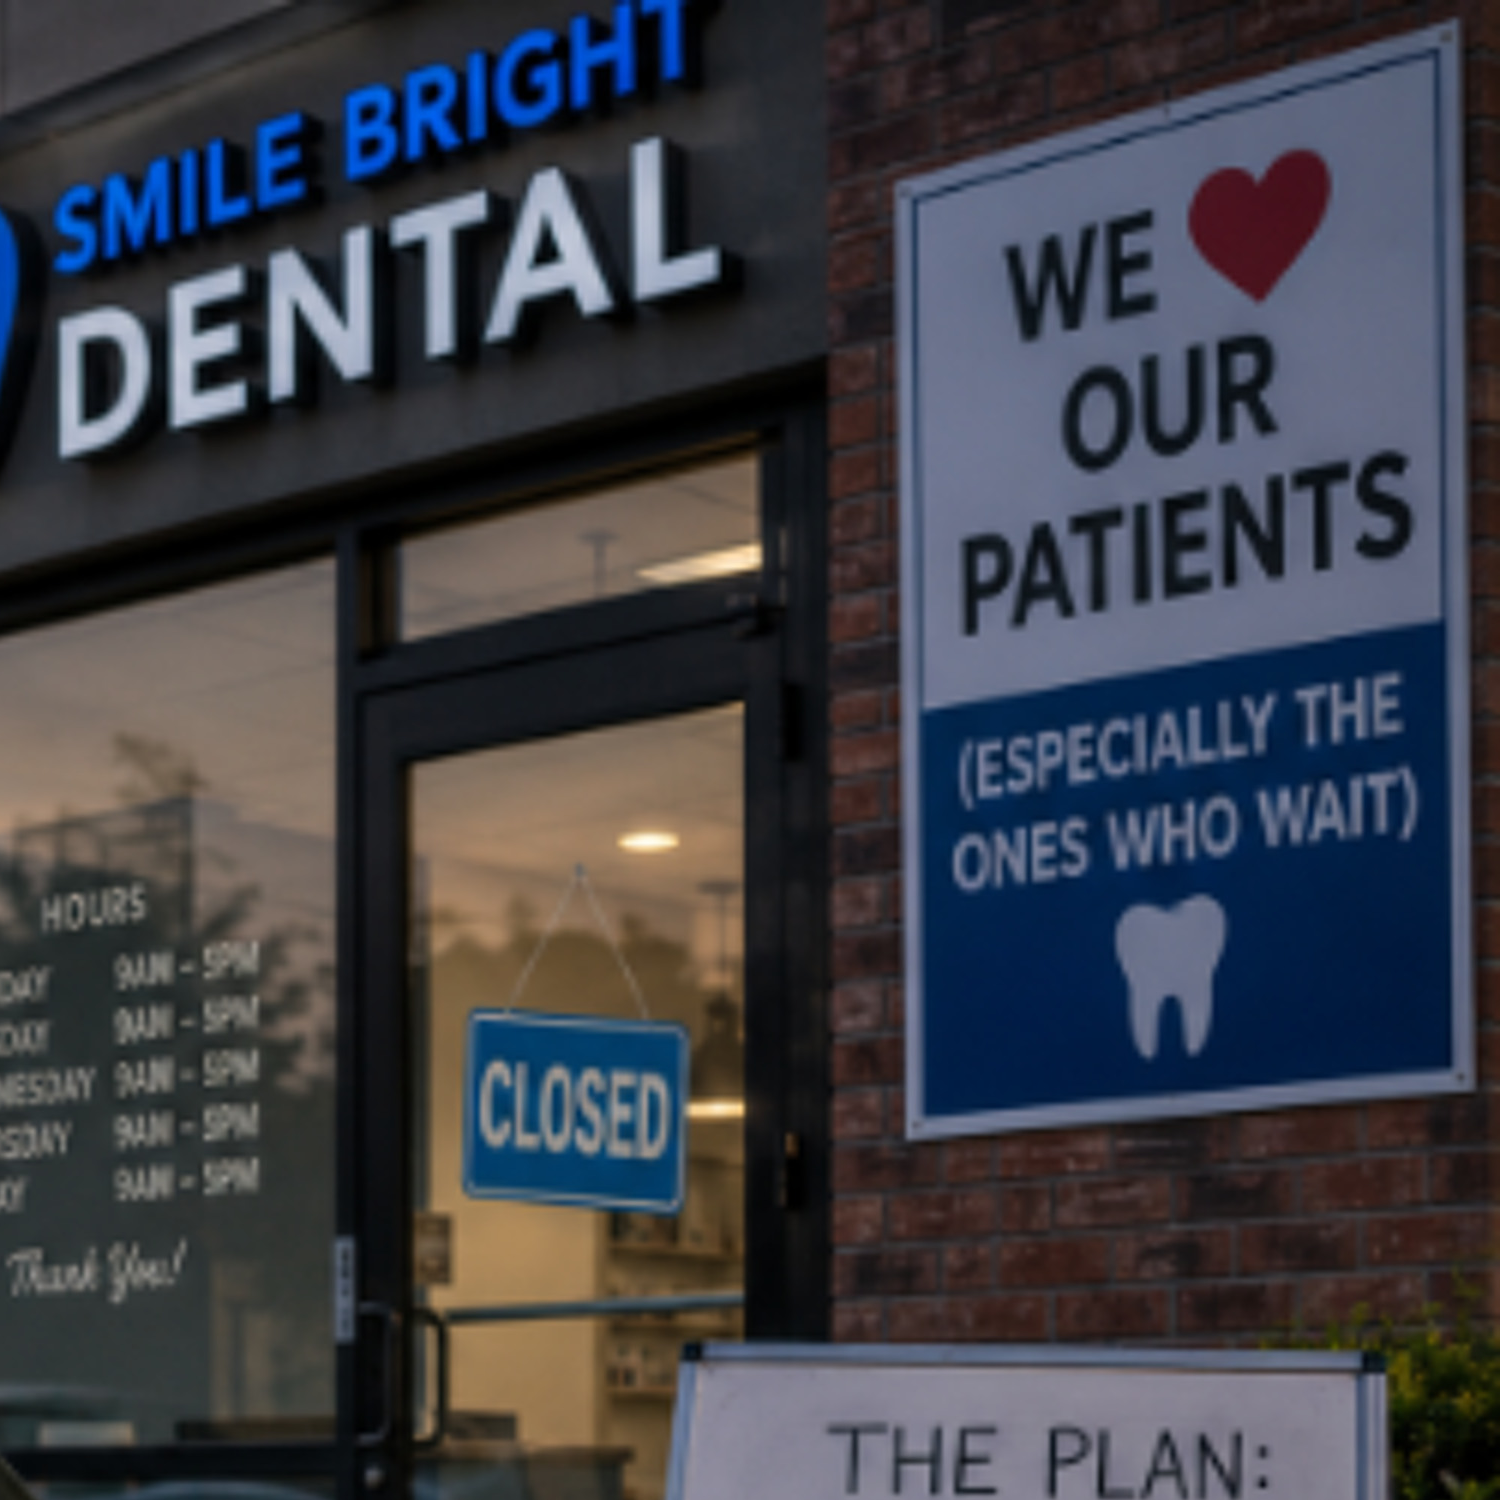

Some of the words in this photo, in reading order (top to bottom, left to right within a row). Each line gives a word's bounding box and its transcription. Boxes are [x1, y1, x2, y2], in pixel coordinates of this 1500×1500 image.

[53, 113, 306, 272] SMILE
[344, 0, 687, 180] BRIGHT
[58, 136, 720, 459] DENTAL
[1004, 210, 1157, 343] WE
[1061, 334, 1277, 473] OUR
[960, 449, 1414, 636] PATIENTS
[958, 692, 1276, 807] (ESPECIALLY
[1296, 672, 1403, 749] THE
[951, 818, 1087, 893] ONES
[1108, 795, 1238, 872] WHO
[1258, 765, 1418, 846] WAIT)
[41, 885, 147, 933] HOURS
[114, 951, 175, 991] 9AM
[202, 941, 260, 981] 5PM
[114, 1005, 175, 1045] 9AM
[202, 995, 260, 1035] 5PM
[114, 1056, 175, 1098] 9AM
[202, 1049, 260, 1088] 5PM
[479, 1060, 670, 1160] CLOSED
[114, 1110, 175, 1151] 9AM
[202, 1103, 260, 1142] 5PM
[114, 1163, 175, 1201] 9AM
[202, 1157, 260, 1195] 5PM
[6, 1245, 98, 1297] Thank
[107, 1238, 187, 1305] You!
[826, 1422, 998, 1495] THE
[1046, 1425, 1272, 1500] PLAN:
